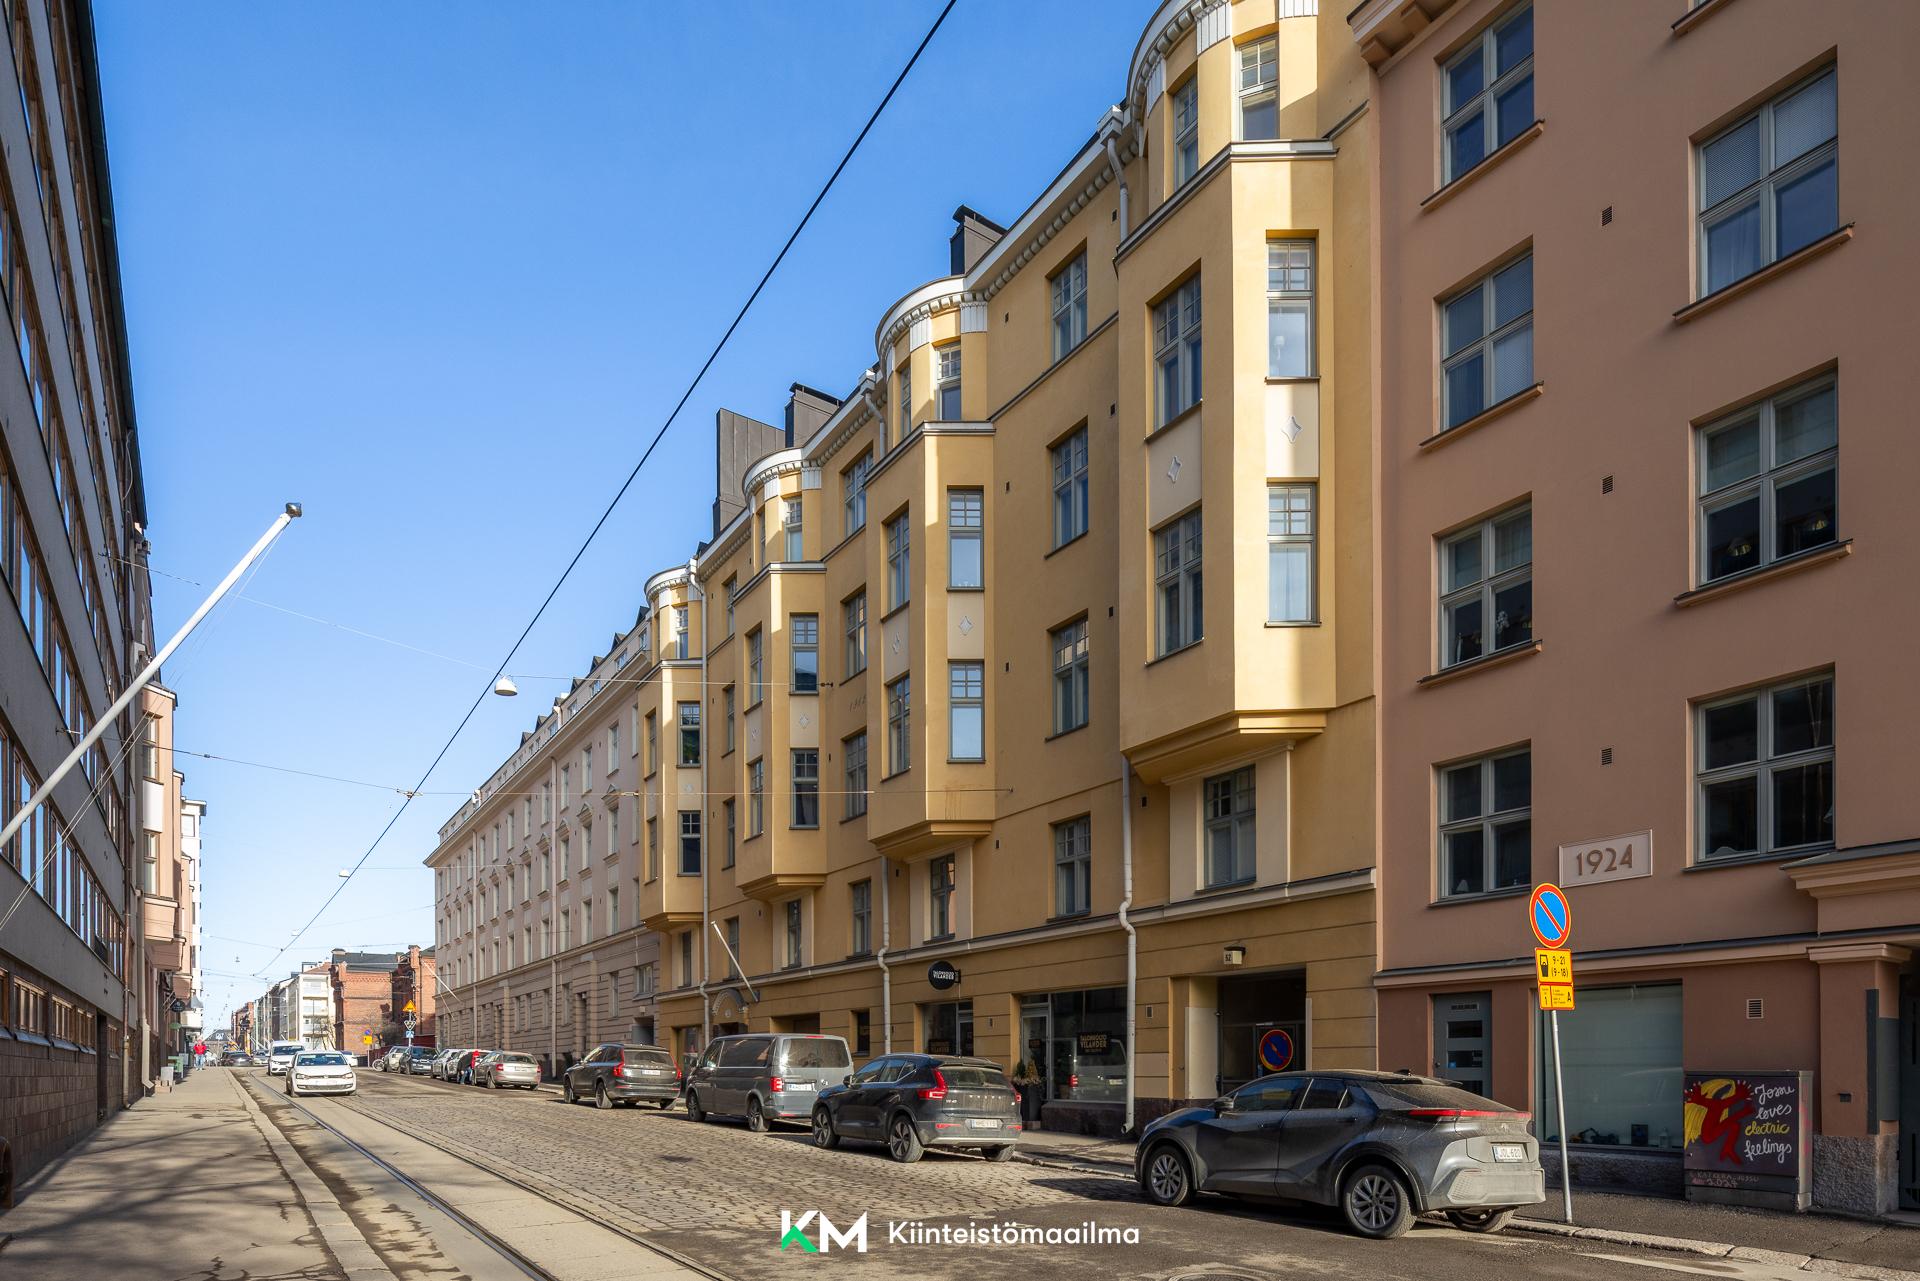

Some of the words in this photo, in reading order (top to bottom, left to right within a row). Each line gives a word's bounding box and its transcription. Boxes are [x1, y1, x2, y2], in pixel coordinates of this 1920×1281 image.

[1576, 843, 1633, 876] 1924
[1755, 1104, 1792, 1120] loves
[1745, 1120, 1790, 1136] electric
[1744, 1138, 1792, 1164] feelings
